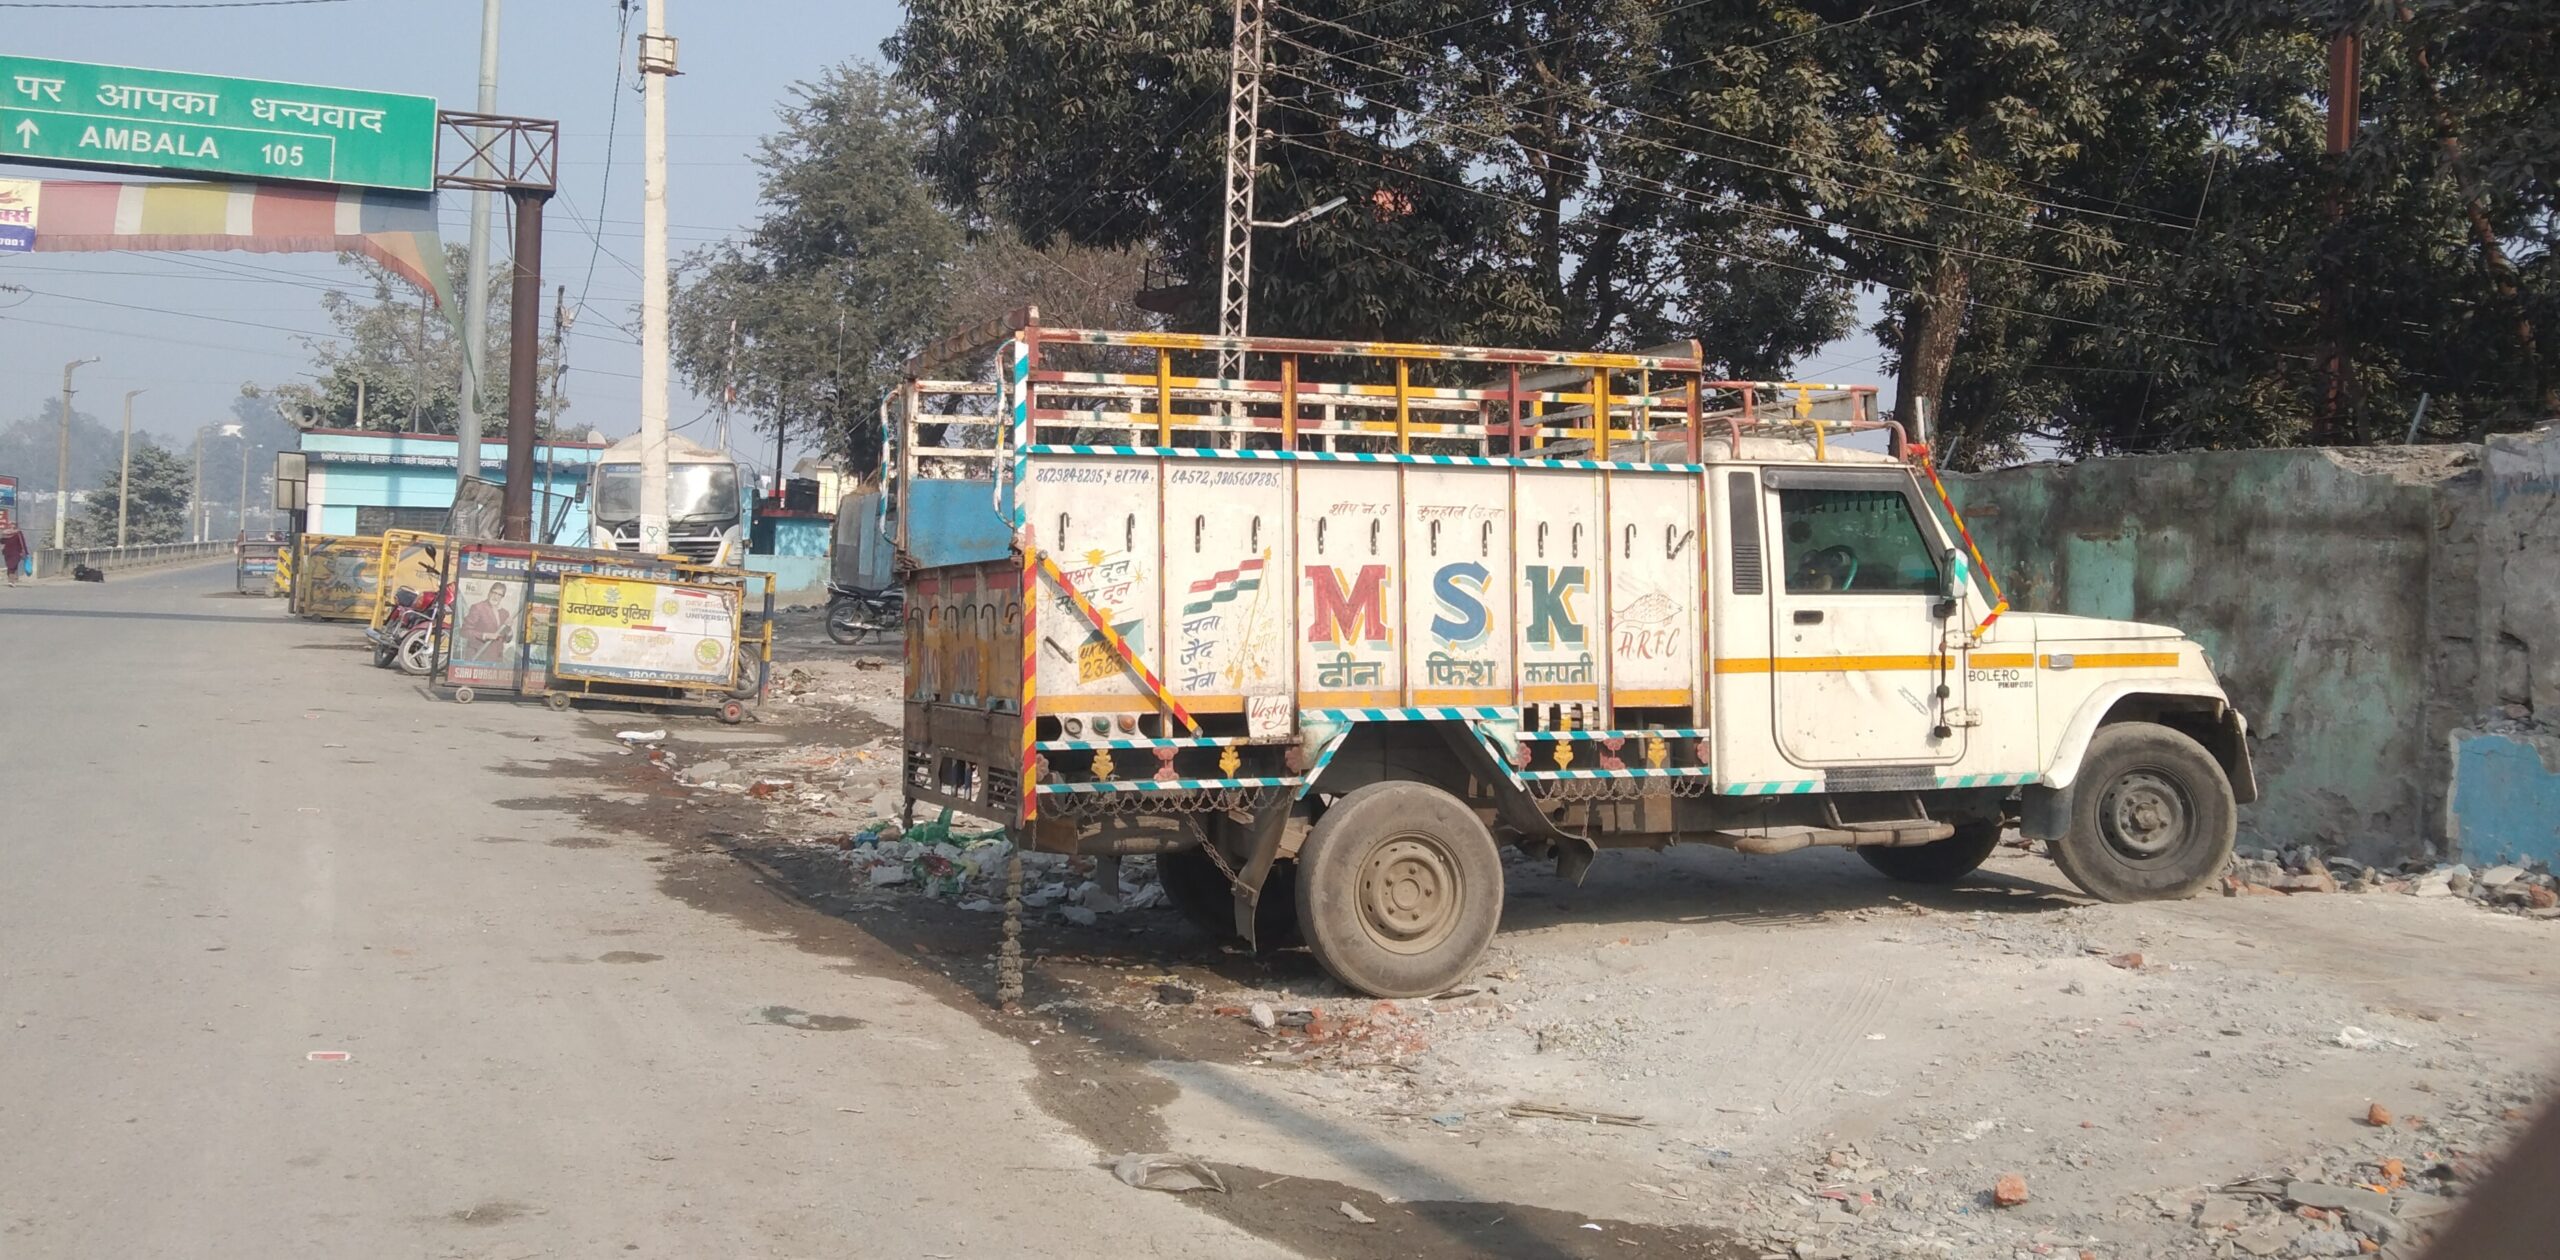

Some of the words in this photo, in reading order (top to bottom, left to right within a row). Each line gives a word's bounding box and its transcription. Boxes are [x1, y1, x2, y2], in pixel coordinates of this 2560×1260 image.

[14, 75, 66, 102] पर
[96, 84, 219, 117] आपका
[251, 98, 387, 133] धन्यवाद
[79, 126, 220, 159] AMBALA
[261, 144, 304, 167] 105
[1100, 560, 1131, 583] दून
[1101, 581, 1133, 604] दून
[567, 602, 619, 618] उत्तराखण्ड
[621, 603, 651, 624] पुलिस
[685, 611, 729, 622] UNIVERSIT
[1305, 564, 1392, 651] M
[1431, 560, 1494, 652] S
[1525, 564, 1591, 651] K
[1968, 669, 2019, 682] BOLERO
